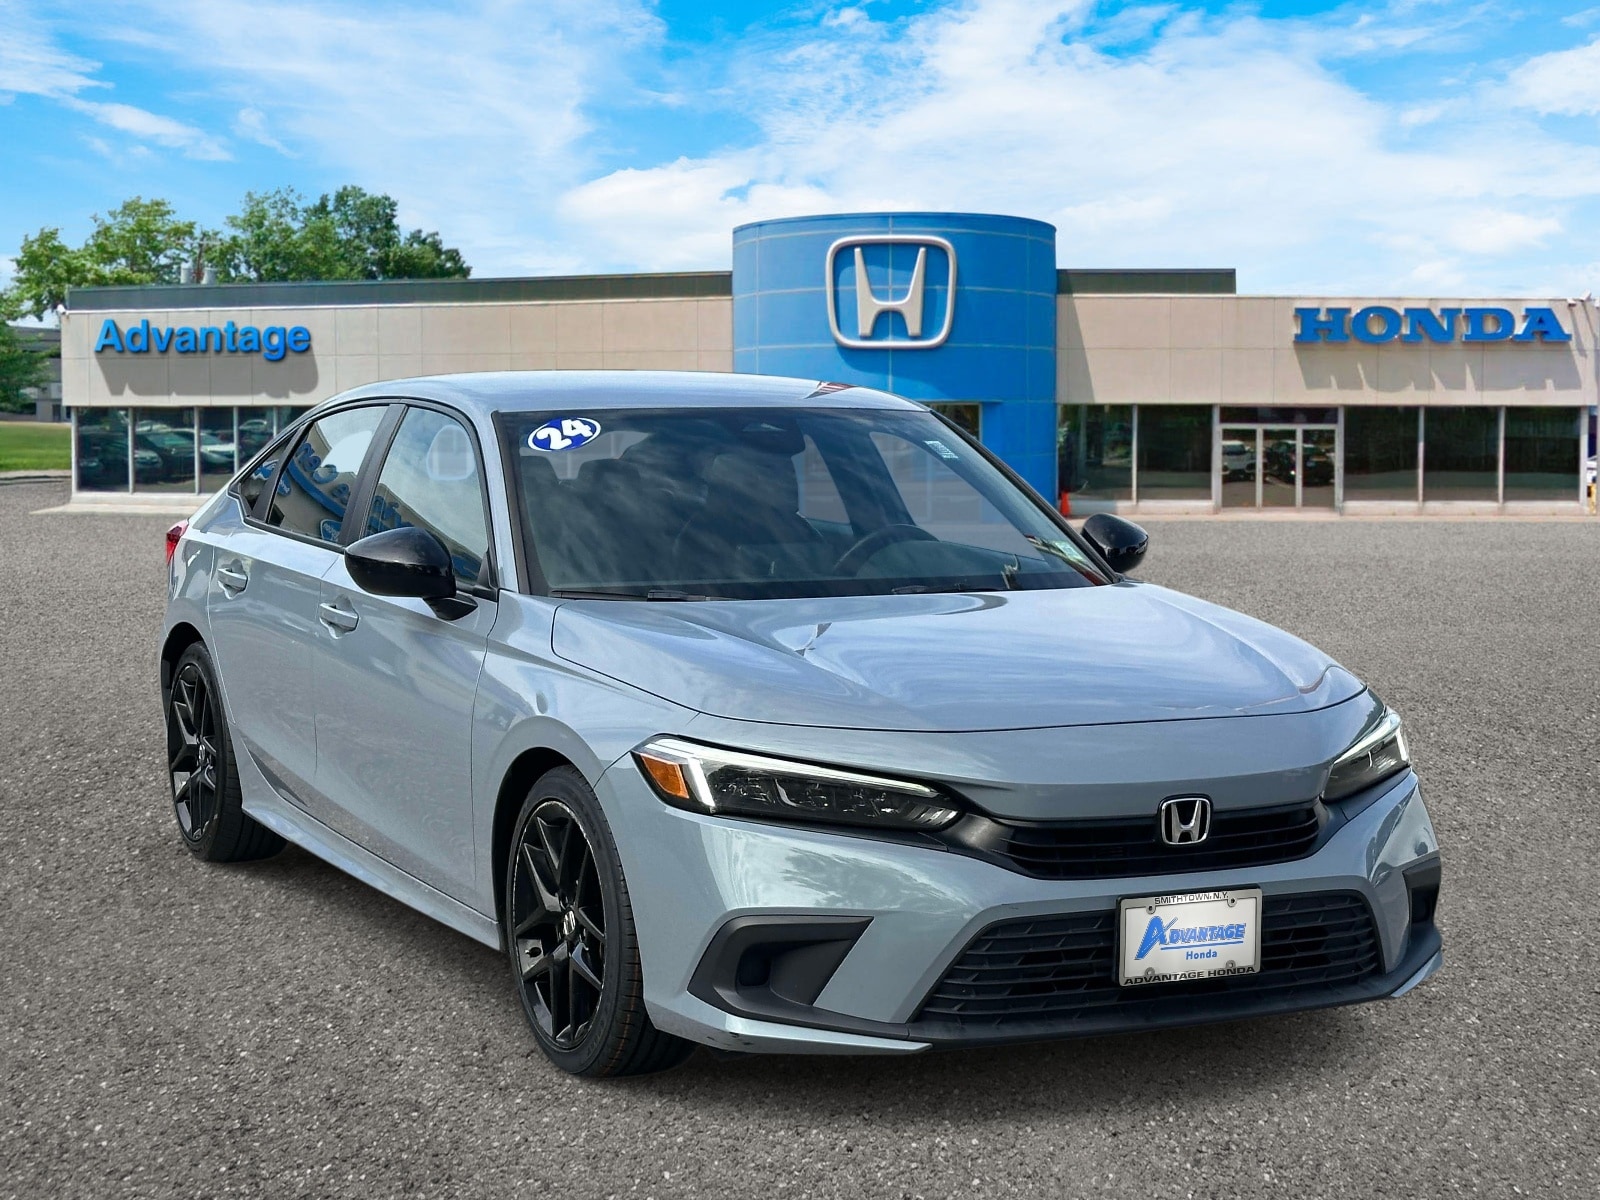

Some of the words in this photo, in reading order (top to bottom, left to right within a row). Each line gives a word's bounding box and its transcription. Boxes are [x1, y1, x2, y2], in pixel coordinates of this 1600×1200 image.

[94, 319, 311, 361] Advantage
[1294, 306, 1572, 344] HONDA
[536, 419, 594, 450] 24
[1185, 950, 1218, 960] Honda
[1123, 970, 1205, 985] ADVANTAGE
[1207, 966, 1255, 977] HONDA
